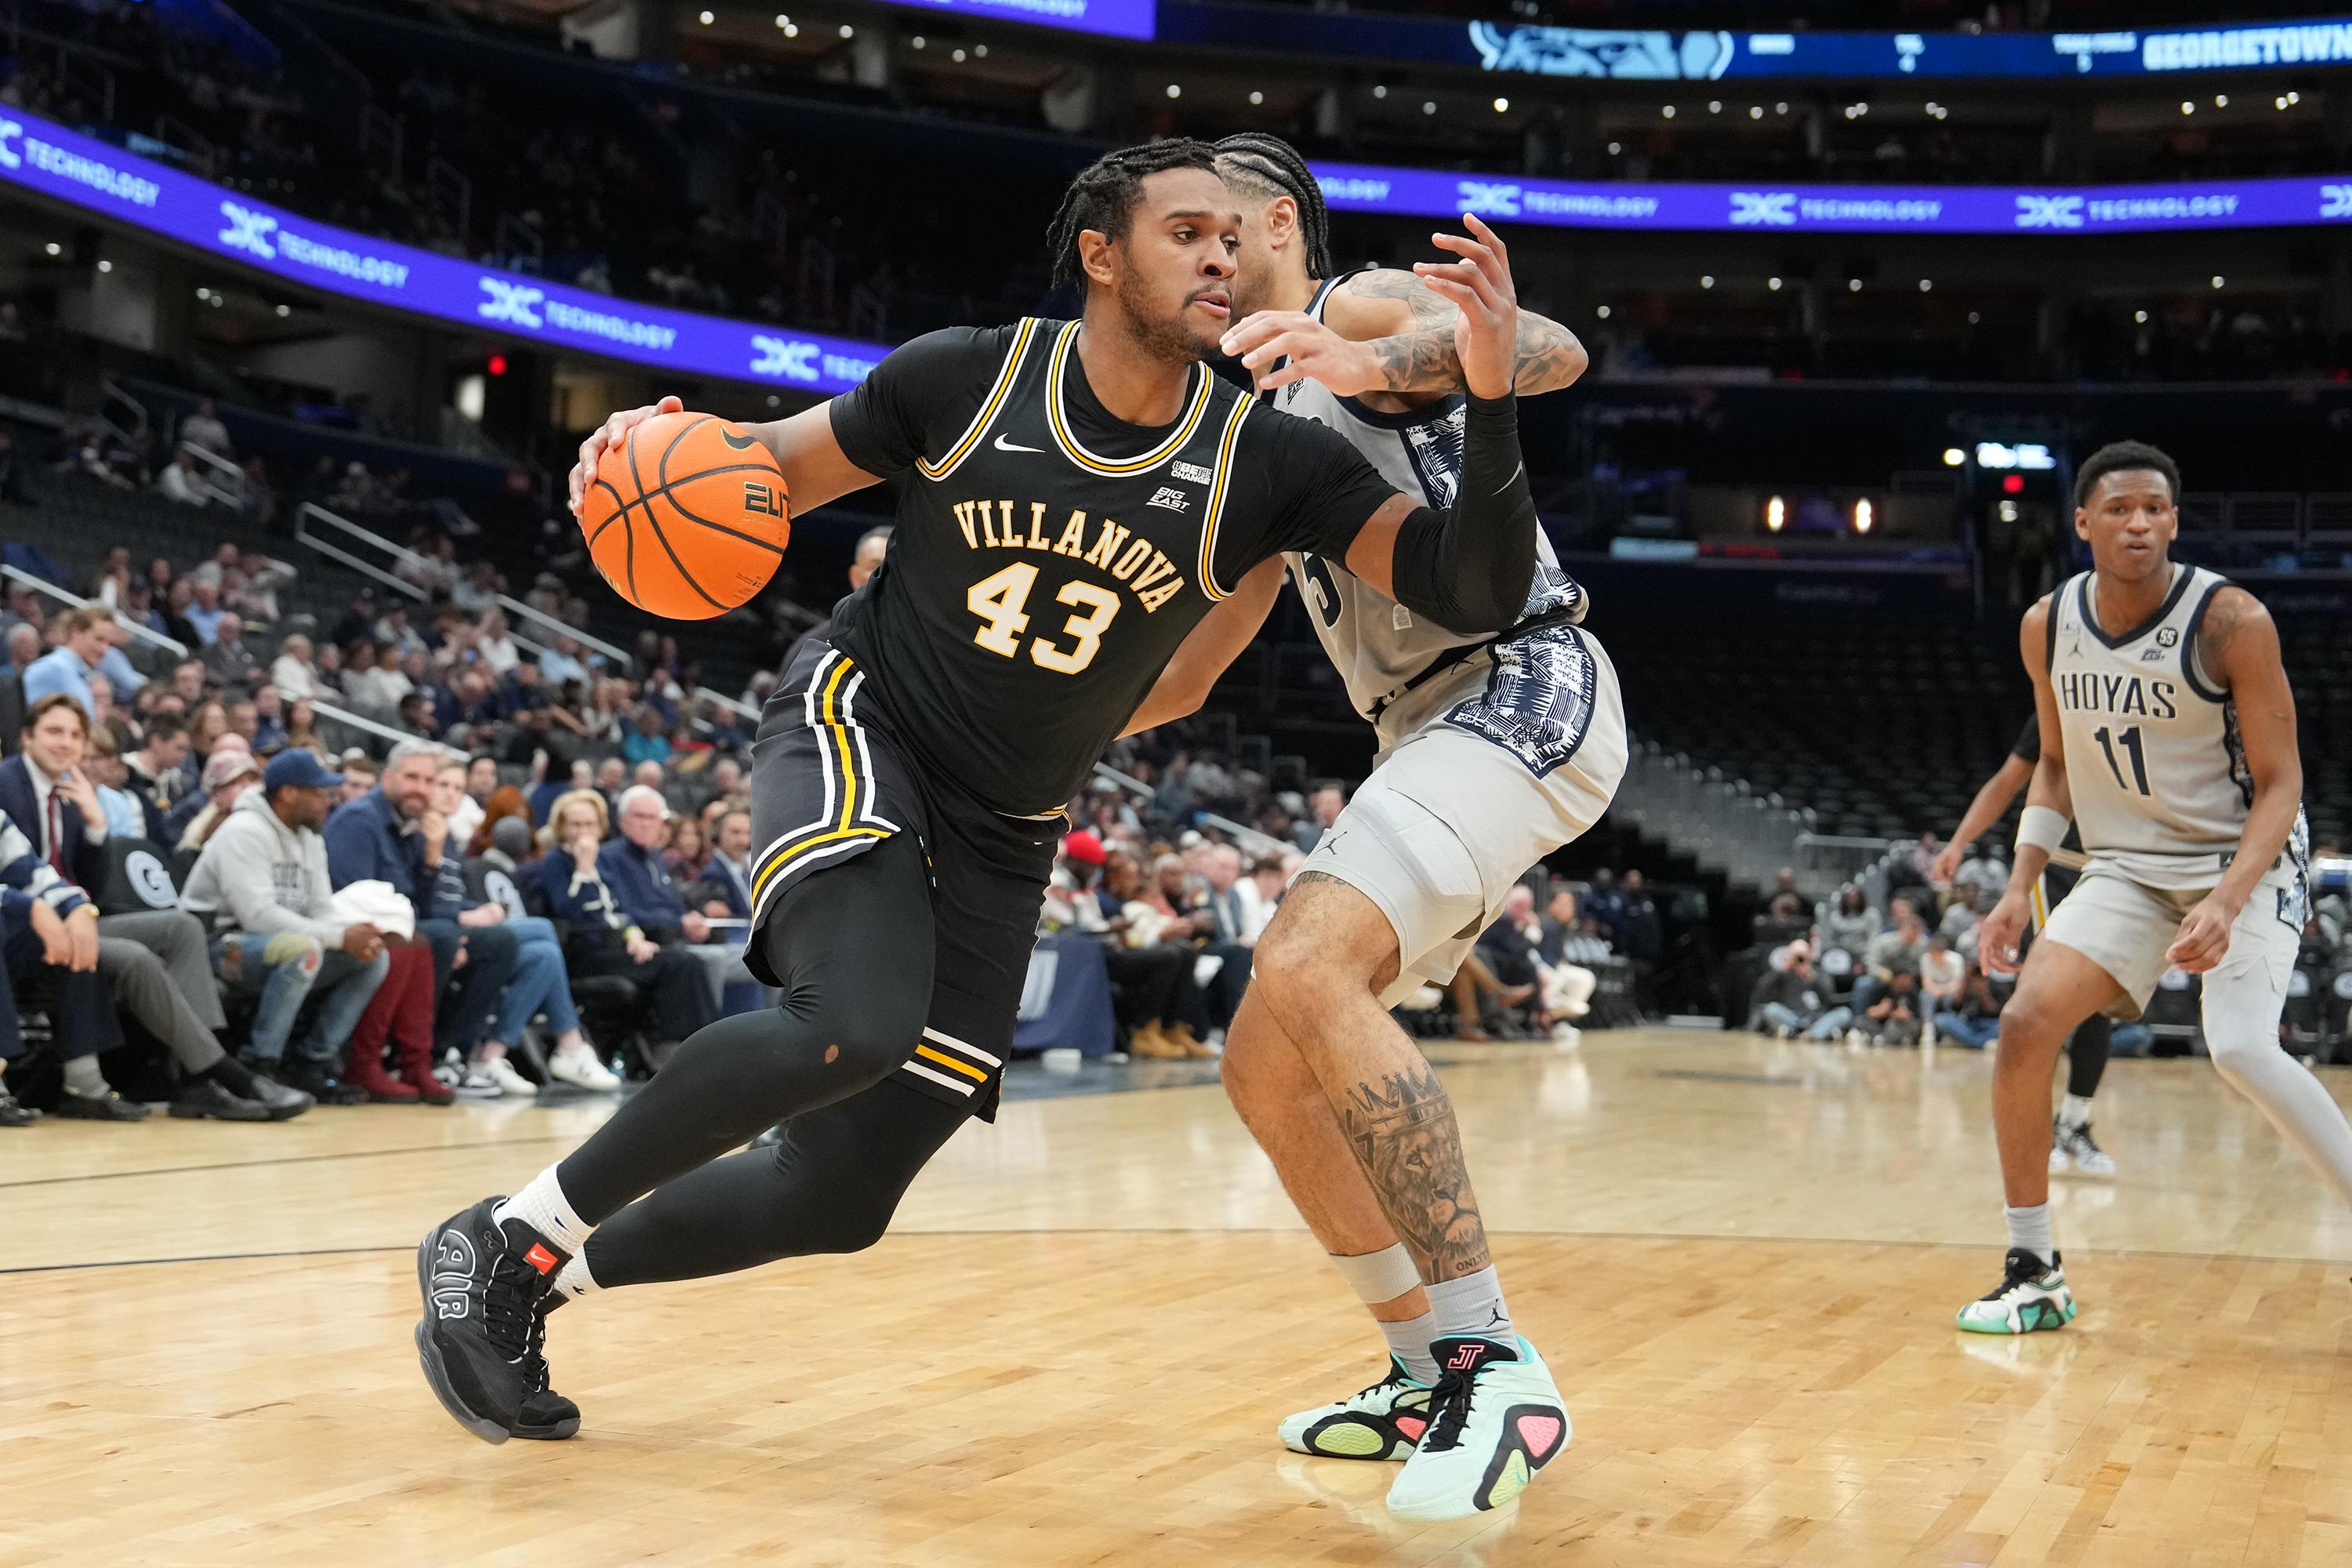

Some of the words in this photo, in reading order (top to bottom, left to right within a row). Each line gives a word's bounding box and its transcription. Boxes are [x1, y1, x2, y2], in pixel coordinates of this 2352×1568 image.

[2143, 24, 2352, 71] GEORGETOWN
[24, 136, 160, 207] TECHNOLOGY
[1318, 177, 1392, 201] OLOGY
[1523, 191, 1660, 218] TECHNOLOGY
[1800, 198, 1943, 222] TECHNOLOGY
[2087, 194, 2239, 221] TECHNOLOGY
[278, 230, 409, 289] TECHNOLOGY
[544, 299, 677, 350] TECHNOLOGY
[1156, 486, 1186, 500] BIG
[1171, 470, 1211, 485] CHANGE
[744, 481, 792, 524] ELIT
[1149, 494, 1190, 510] EAST
[953, 499, 1185, 614] VILLANOVA
[967, 561, 1122, 675] 43
[2060, 672, 2177, 720] HOYAS
[2092, 724, 2152, 797] 11
